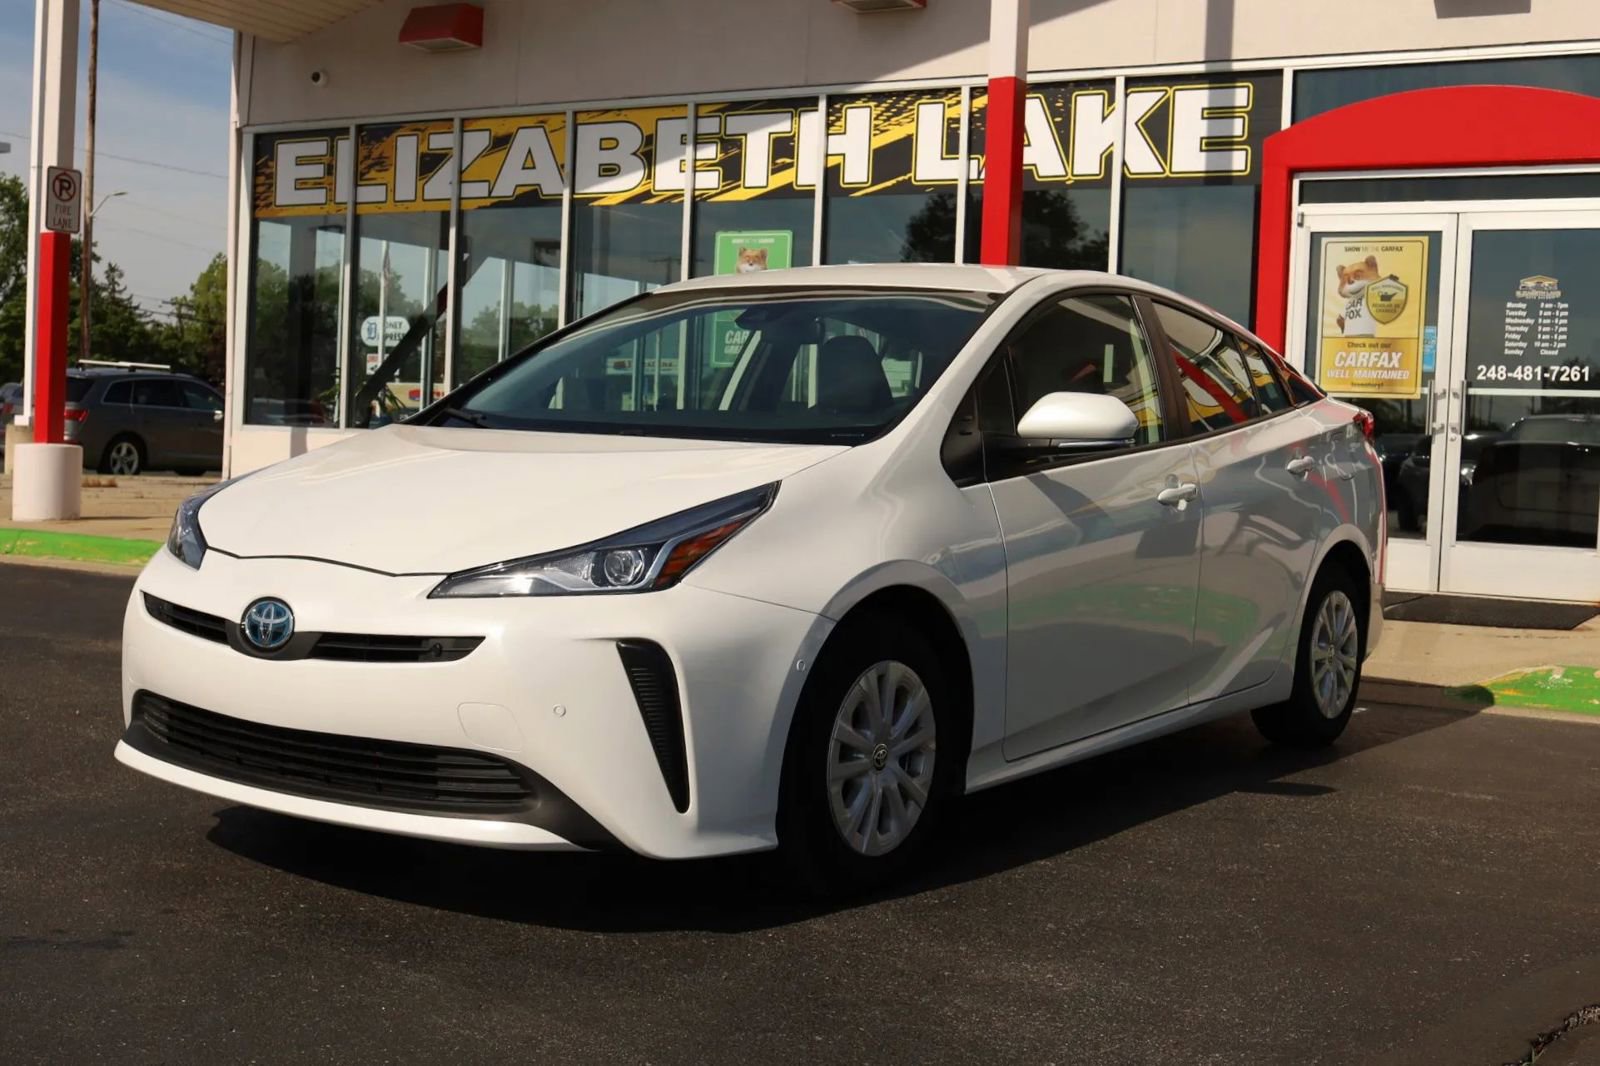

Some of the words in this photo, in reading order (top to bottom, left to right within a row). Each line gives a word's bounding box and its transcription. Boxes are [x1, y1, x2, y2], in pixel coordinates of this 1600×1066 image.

[274, 105, 871, 206] ELIZABETH
[913, 83, 1252, 184] LAKE
[53, 216, 72, 228] LANE
[1505, 309, 1527, 317] Tuesday
[1505, 317, 1535, 325] Wednesday
[1505, 325, 1529, 333] Thursday
[725, 330, 750, 345] CAR
[1504, 333, 1521, 341] Friday
[1504, 341, 1528, 349] Saturday
[1504, 349, 1524, 357] Sunday
[1334, 351, 1402, 368] CARFAX
[1327, 369, 1350, 378] WELL
[1353, 369, 1410, 379] MAINTAINED
[1476, 365, 1590, 382] 248-481-7261
